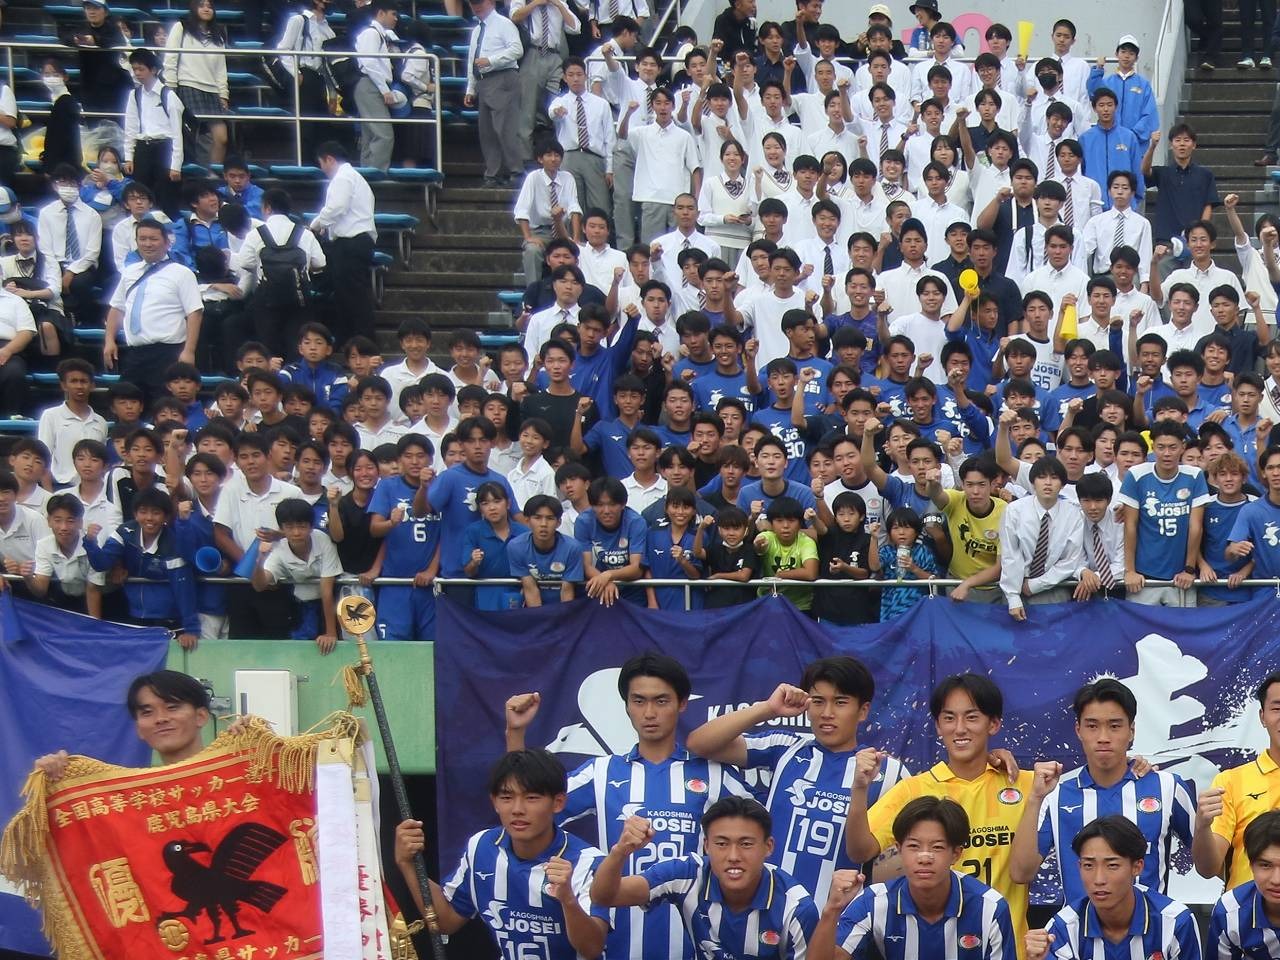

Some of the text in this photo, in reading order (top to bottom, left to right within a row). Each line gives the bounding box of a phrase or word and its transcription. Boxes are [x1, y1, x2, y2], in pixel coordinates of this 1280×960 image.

[1157, 505, 1190, 517] JOSEI
[414, 523, 426, 542] 6
[1158, 518, 1177, 536] 15
[147, 792, 261, 834] 鹿児島県大会
[647, 809, 694, 820] KAGOSHIMA
[805, 817, 836, 857] 19
[88, 856, 150, 929] 優
[510, 911, 554, 923] KAGOSHIMA
[504, 919, 562, 935] JOSEI
